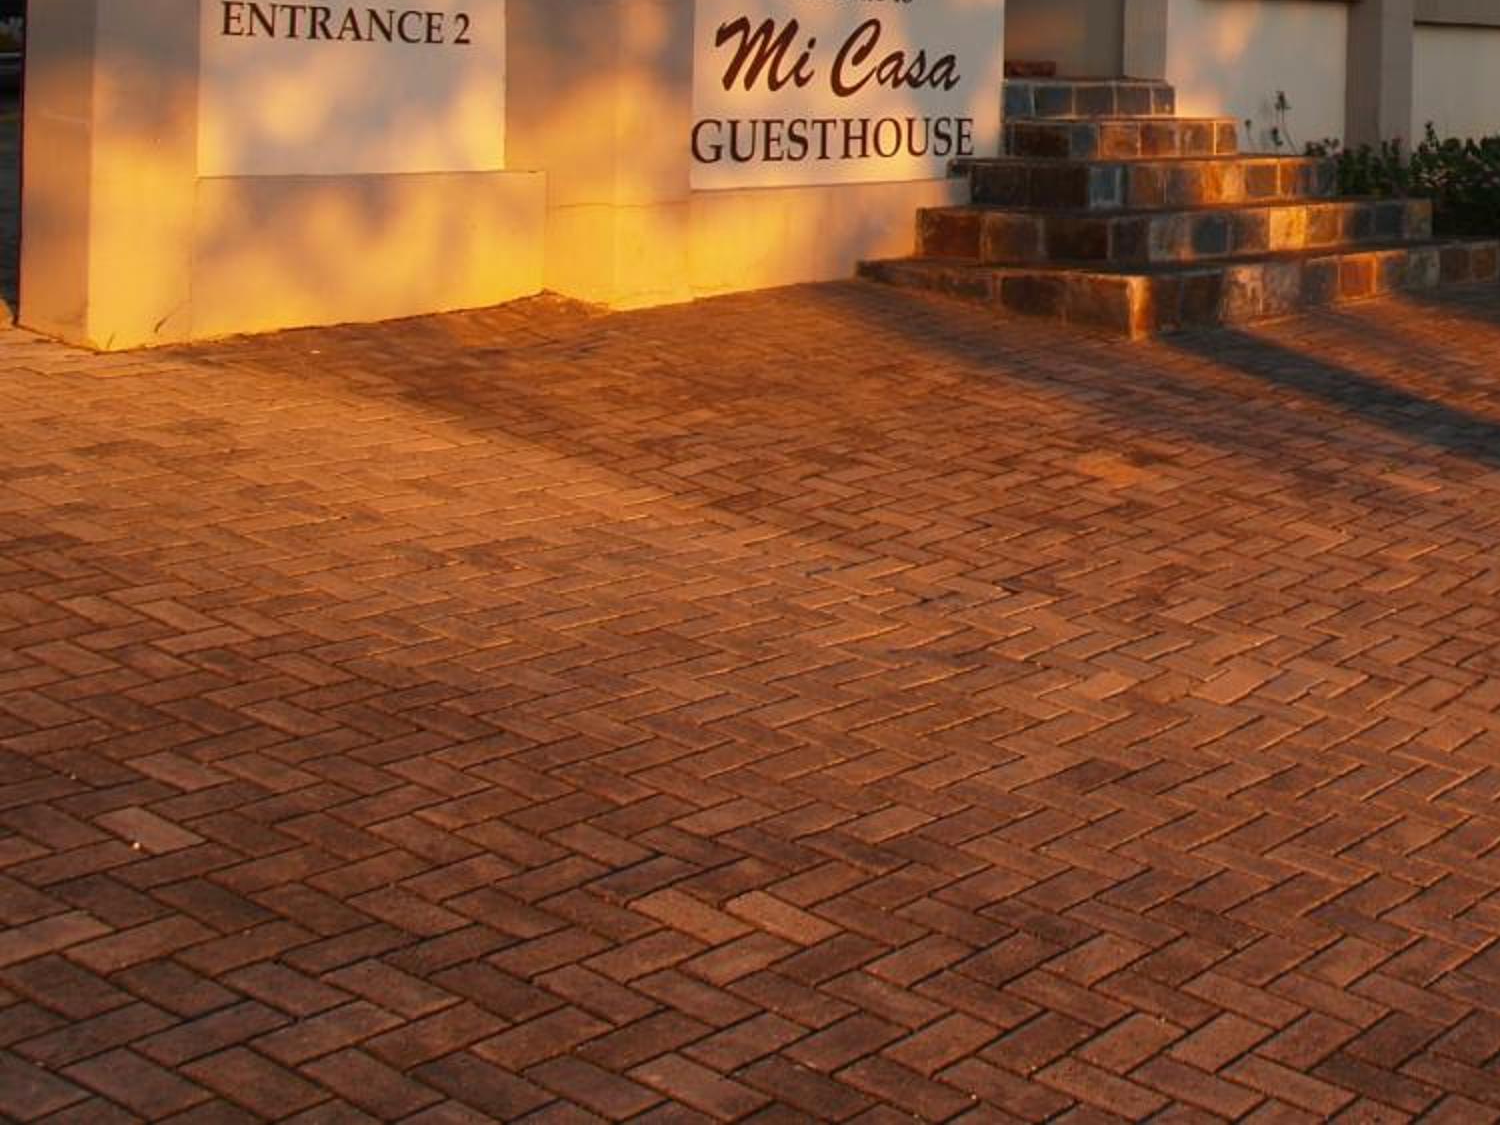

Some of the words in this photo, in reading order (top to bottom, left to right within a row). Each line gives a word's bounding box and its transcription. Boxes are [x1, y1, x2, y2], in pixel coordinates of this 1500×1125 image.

[221, 1, 445, 44] ENTRANCE
[453, 13, 472, 44] 2
[715, 16, 817, 92] Mi
[830, 18, 961, 98] Casa
[691, 117, 974, 164] GUESTHOUSE
